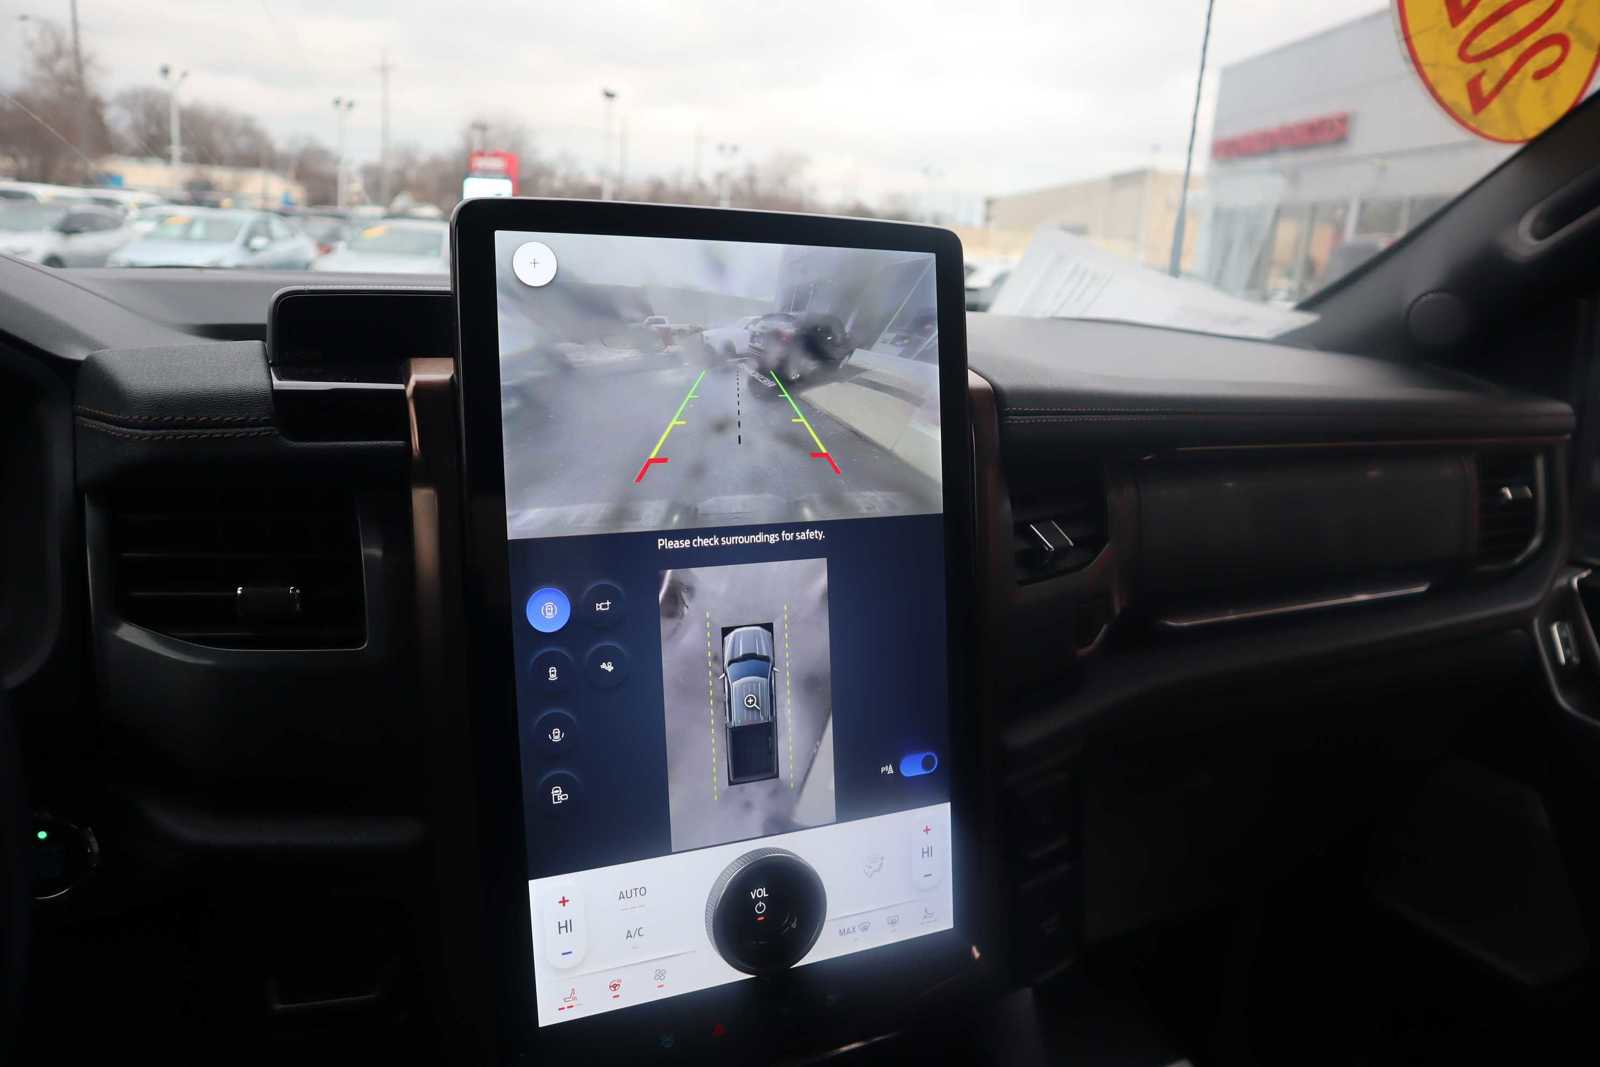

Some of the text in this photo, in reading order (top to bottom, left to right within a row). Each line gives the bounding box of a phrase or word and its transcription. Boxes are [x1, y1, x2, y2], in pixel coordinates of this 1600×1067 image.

[658, 529, 825, 550] Please check surroundings for safety.
[921, 845, 933, 859] HI
[618, 886, 647, 901] AUTO
[751, 888, 768, 899] VOL
[558, 919, 573, 935] HI
[625, 927, 644, 940] A/C
[838, 925, 857, 937] MAX
